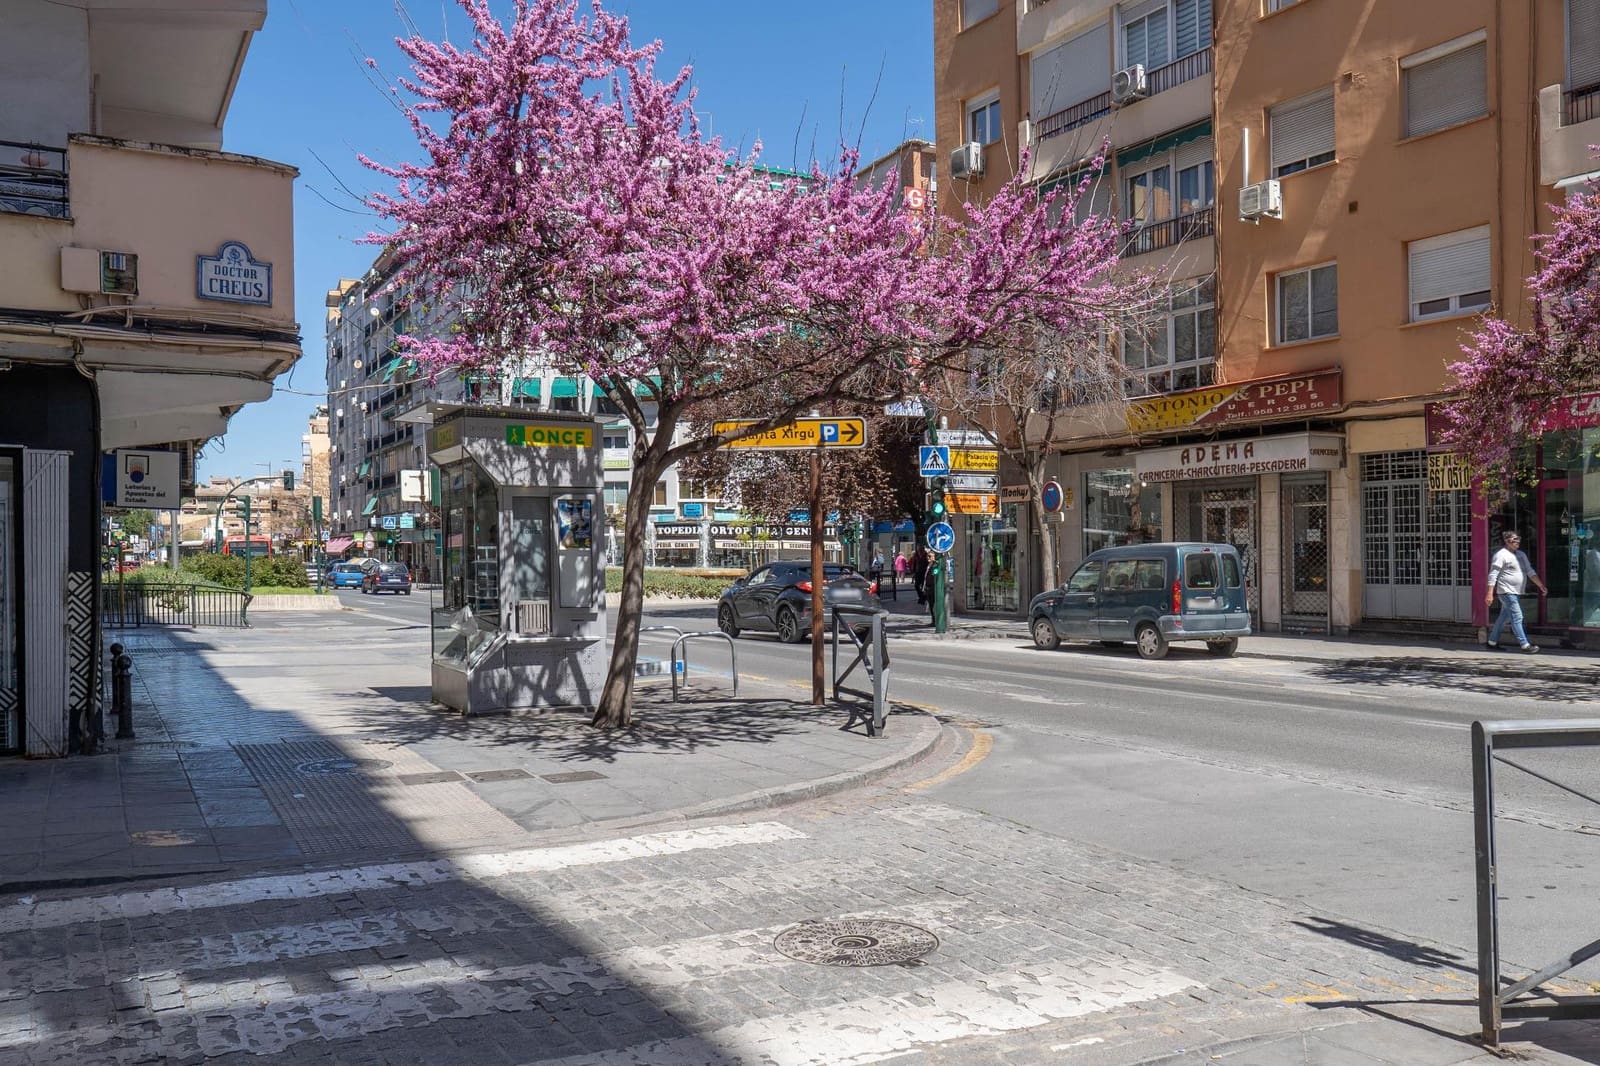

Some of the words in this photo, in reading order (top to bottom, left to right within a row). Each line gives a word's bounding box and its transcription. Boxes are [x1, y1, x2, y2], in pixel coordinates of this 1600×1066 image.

[214, 265, 257, 279] DOCTOR
[209, 278, 263, 297] CREUS
[1136, 392, 1224, 416] ANTONIO
[1259, 379, 1315, 398] PEPI
[1253, 408, 1273, 416] 958
[1277, 405, 1290, 413] 12
[1310, 401, 1324, 409] 56
[532, 430, 586, 445] ONCE
[782, 428, 815, 442] Xirgú
[823, 425, 836, 441] P
[1181, 441, 1254, 465] ADEMA
[1429, 456, 1440, 467] SE
[1430, 468, 1445, 489] 667
